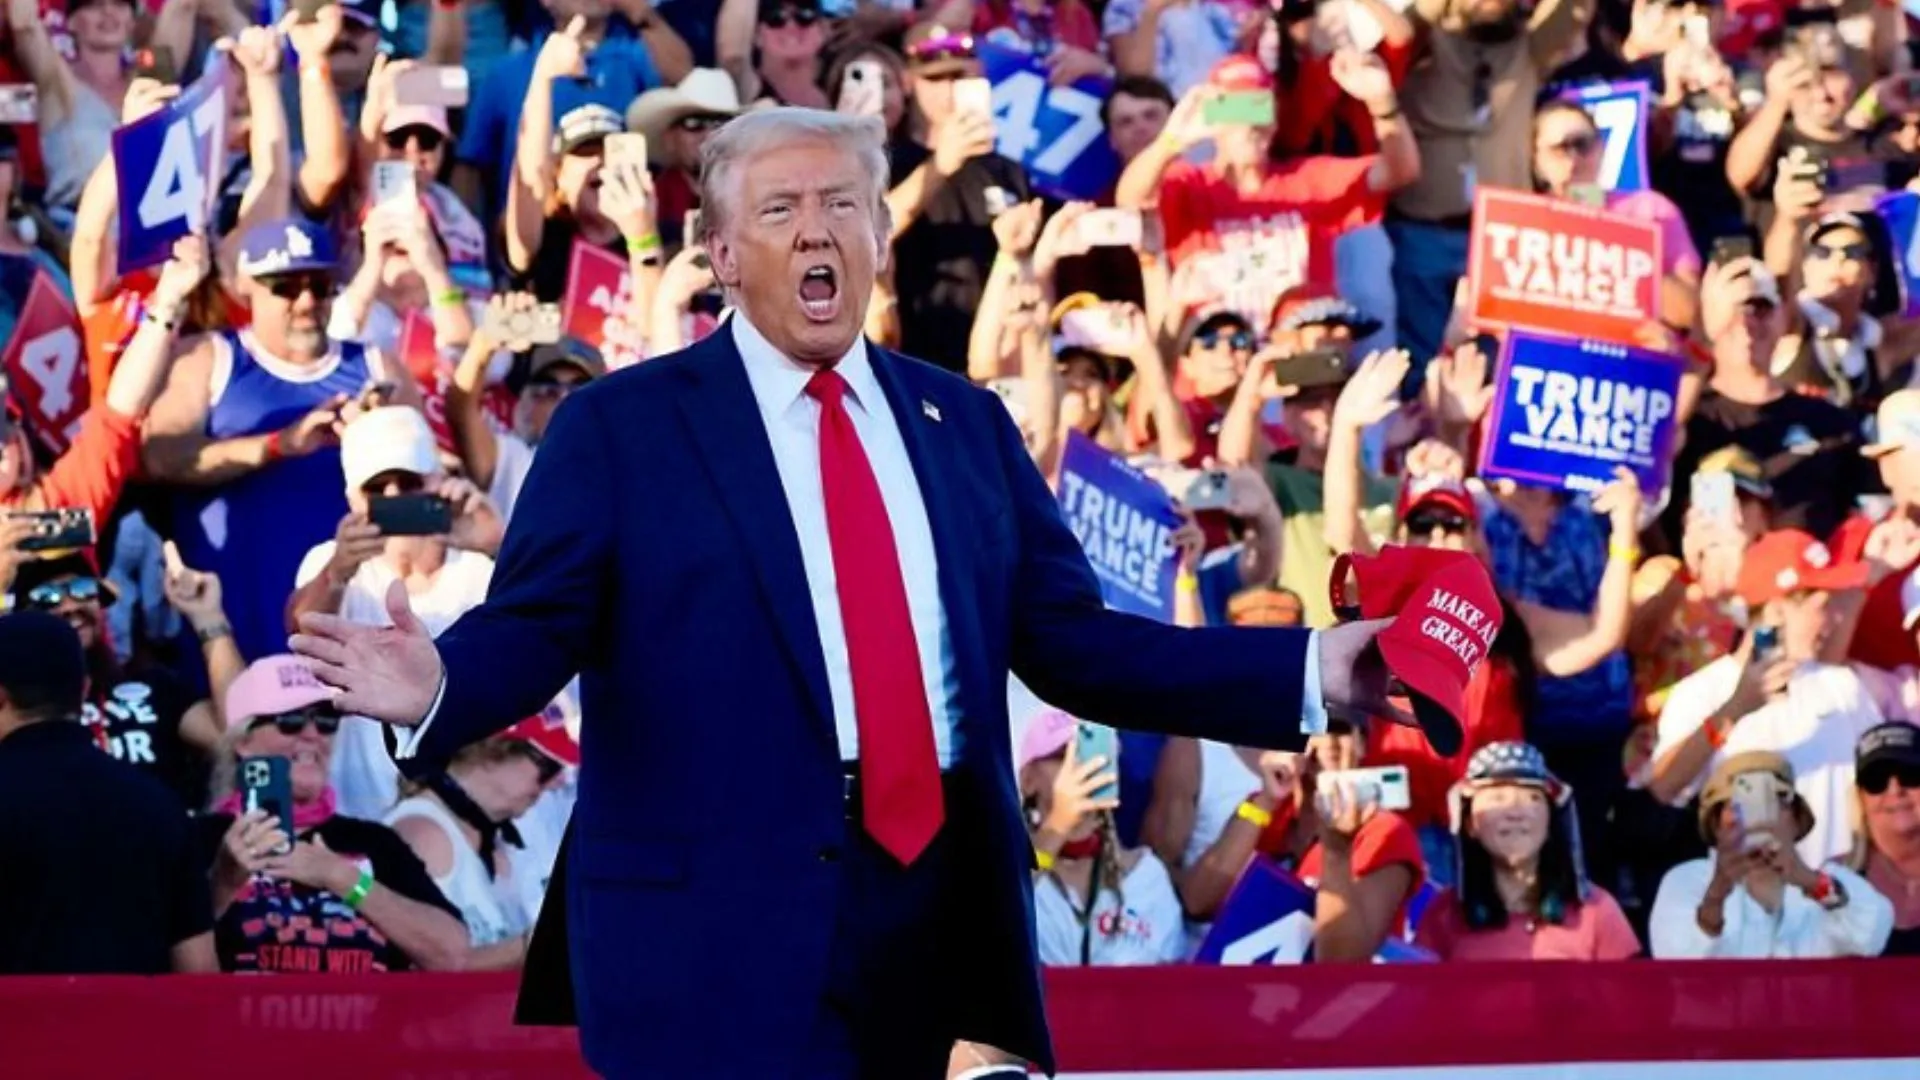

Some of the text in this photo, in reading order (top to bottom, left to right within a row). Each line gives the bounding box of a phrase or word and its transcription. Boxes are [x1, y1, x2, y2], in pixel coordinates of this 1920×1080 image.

[991, 69, 1104, 176] 47
[138, 85, 225, 235] 47
[1486, 222, 1653, 279] TRUMP
[1503, 256, 1638, 309] VANCE
[1511, 365, 1671, 425] TRUMP
[1525, 403, 1657, 455] VANCE
[1063, 470, 1177, 566] TRUMP
[1069, 514, 1160, 593] VANCE
[1426, 587, 1485, 632] MAKE
[1421, 615, 1479, 665] GREAT
[258, 944, 373, 973] STAND WITH
